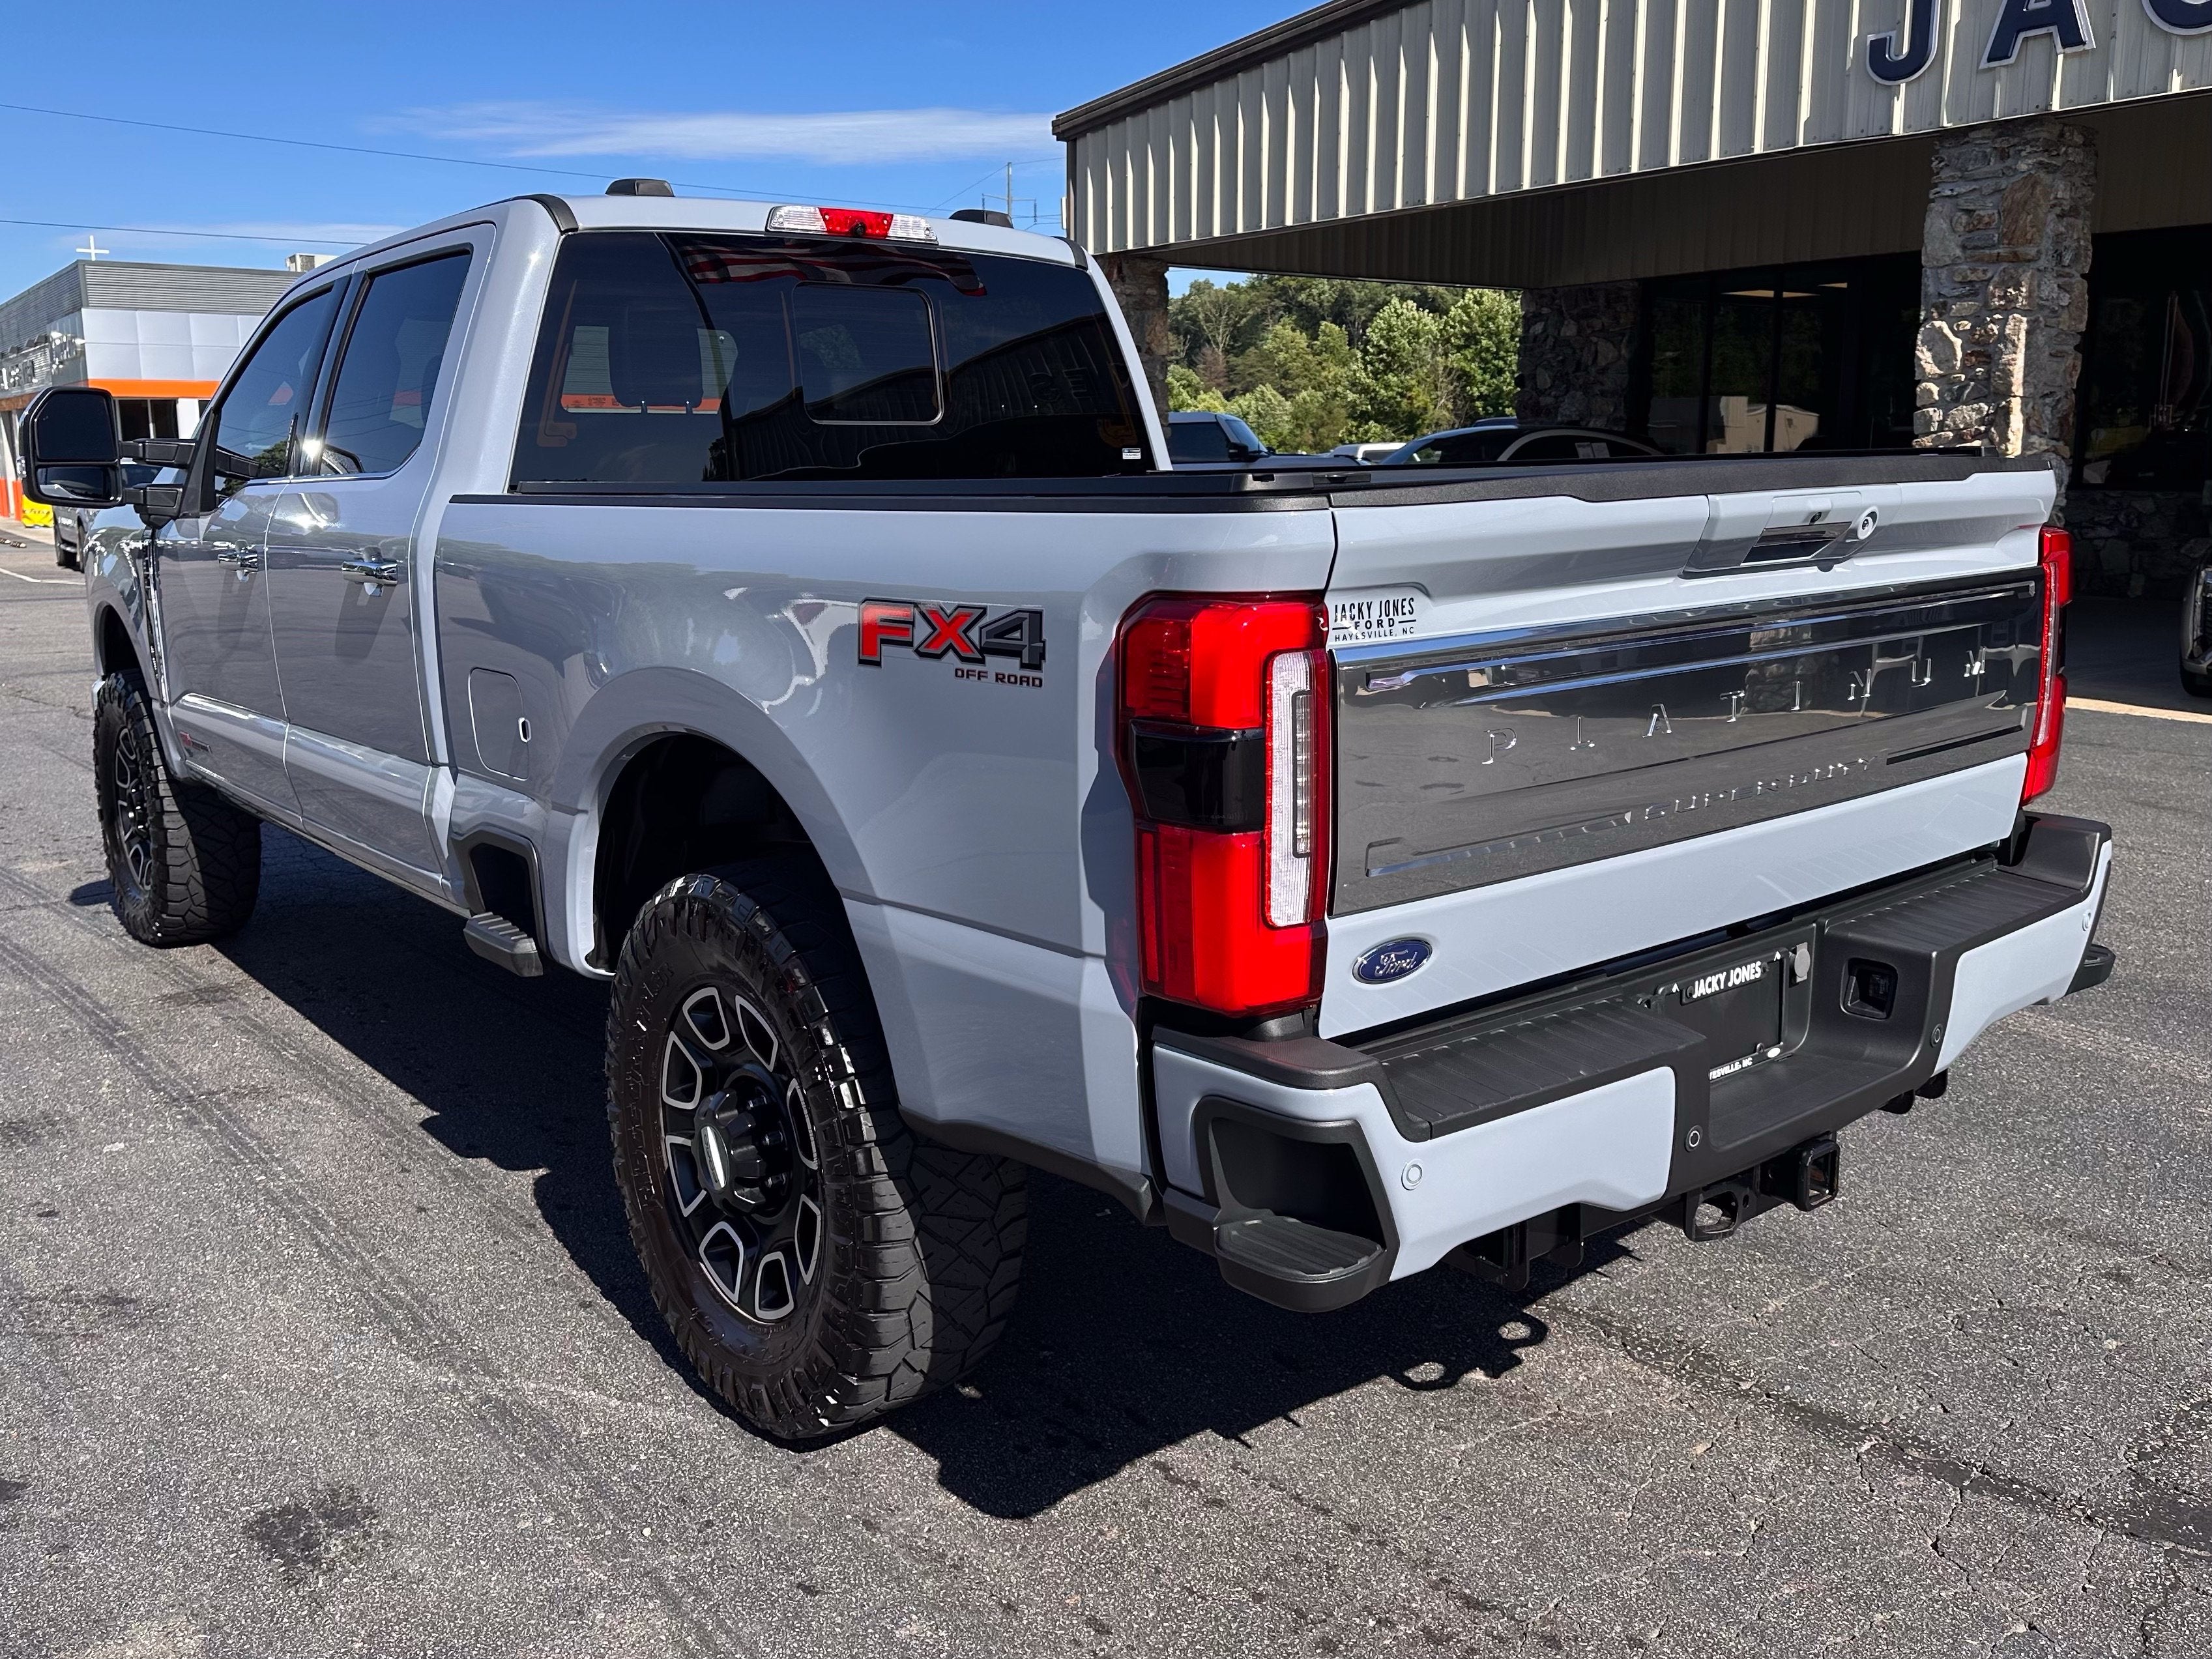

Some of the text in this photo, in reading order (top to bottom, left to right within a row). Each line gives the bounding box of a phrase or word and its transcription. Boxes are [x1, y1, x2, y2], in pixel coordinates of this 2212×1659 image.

[1334, 597, 1414, 622] JACKY JONES
[858, 596, 1047, 671] FX4
[1354, 618, 1395, 630] FORD
[1403, 626, 1414, 635] NC
[954, 668, 1043, 688] OFF ROAD
[1481, 646, 1986, 764] PLATINUM
[1692, 960, 1762, 999] JACKY JONES
